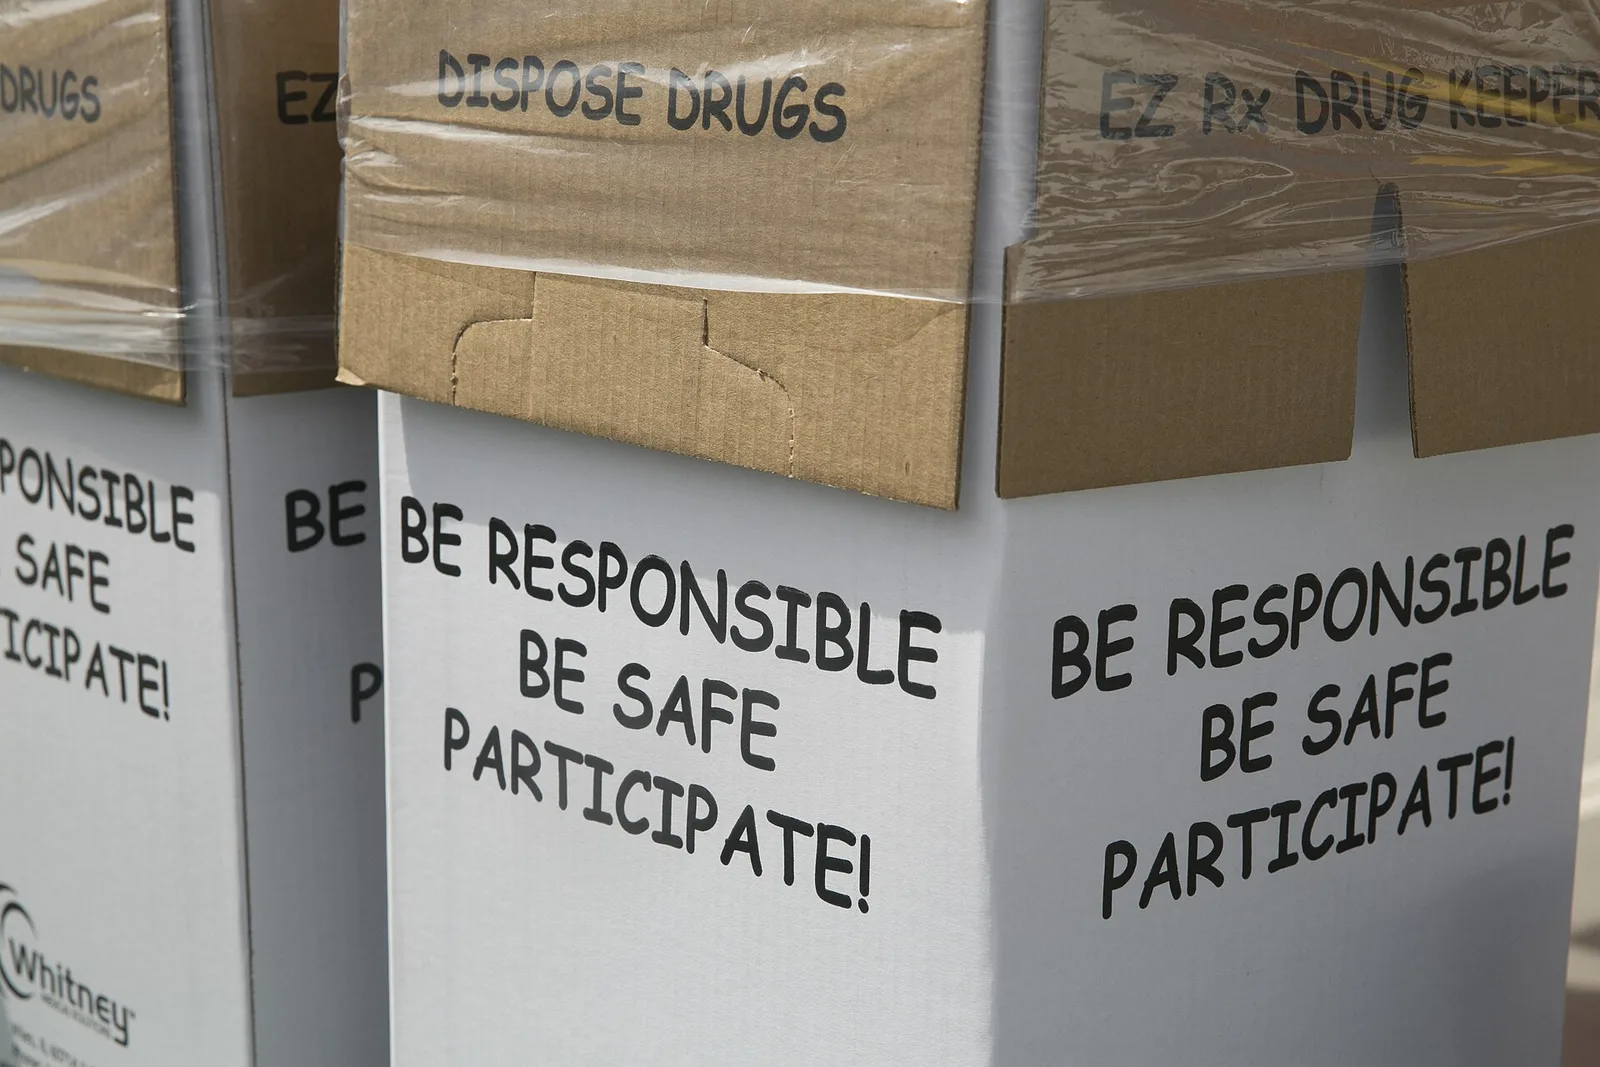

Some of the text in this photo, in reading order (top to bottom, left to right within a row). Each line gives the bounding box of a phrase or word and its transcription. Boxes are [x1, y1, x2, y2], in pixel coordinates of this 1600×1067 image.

[0, 64, 101, 123] DRUGS
[276, 71, 339, 125] EZ
[437, 49, 848, 143] DISPOSE DRUGS
[1100, 64, 1600, 140] EZ Rx DRUG KEEPER
[285, 479, 367, 553] BE
[15, 533, 110, 614] SAFE
[400, 495, 943, 700] BE RESPONSIBLE
[1051, 523, 1575, 700] BE RESPONSIBLE
[0, 607, 170, 722] ICIPATE!
[519, 628, 780, 772] BE SAFE
[1200, 652, 1453, 783] BE SAFE
[444, 707, 871, 914] PARTICIPATE!
[1102, 735, 1516, 920] PARTICIPATE!
[8, 936, 130, 1047] Whitney
